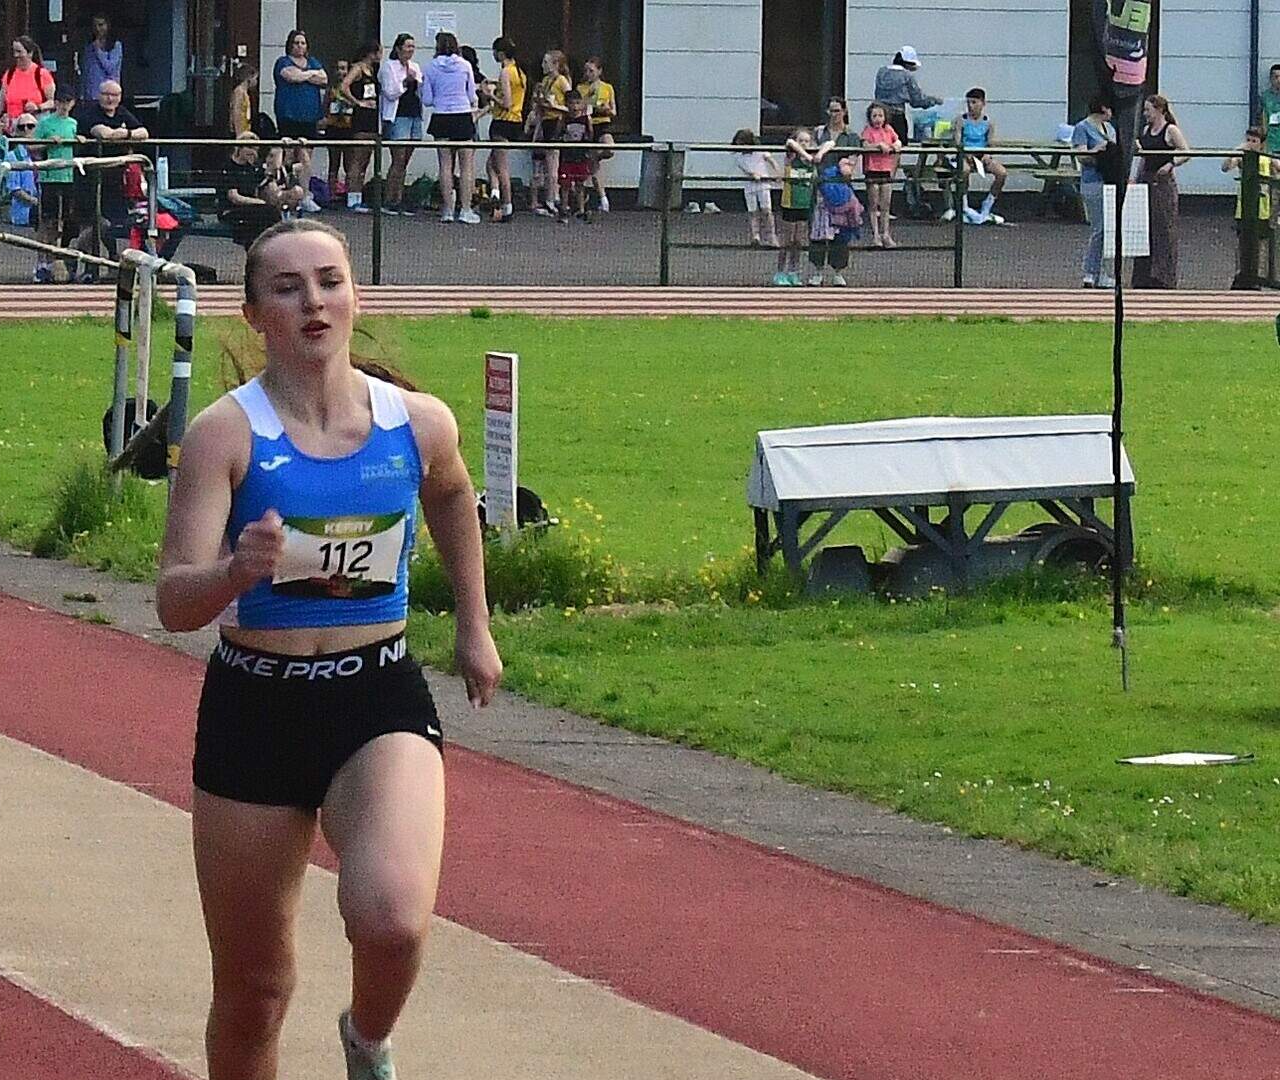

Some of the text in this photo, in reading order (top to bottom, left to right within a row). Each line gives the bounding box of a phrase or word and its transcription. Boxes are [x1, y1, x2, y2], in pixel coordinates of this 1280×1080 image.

[319, 540, 373, 575] 112
[217, 639, 279, 677] NIKE
[282, 655, 363, 681] PRO
